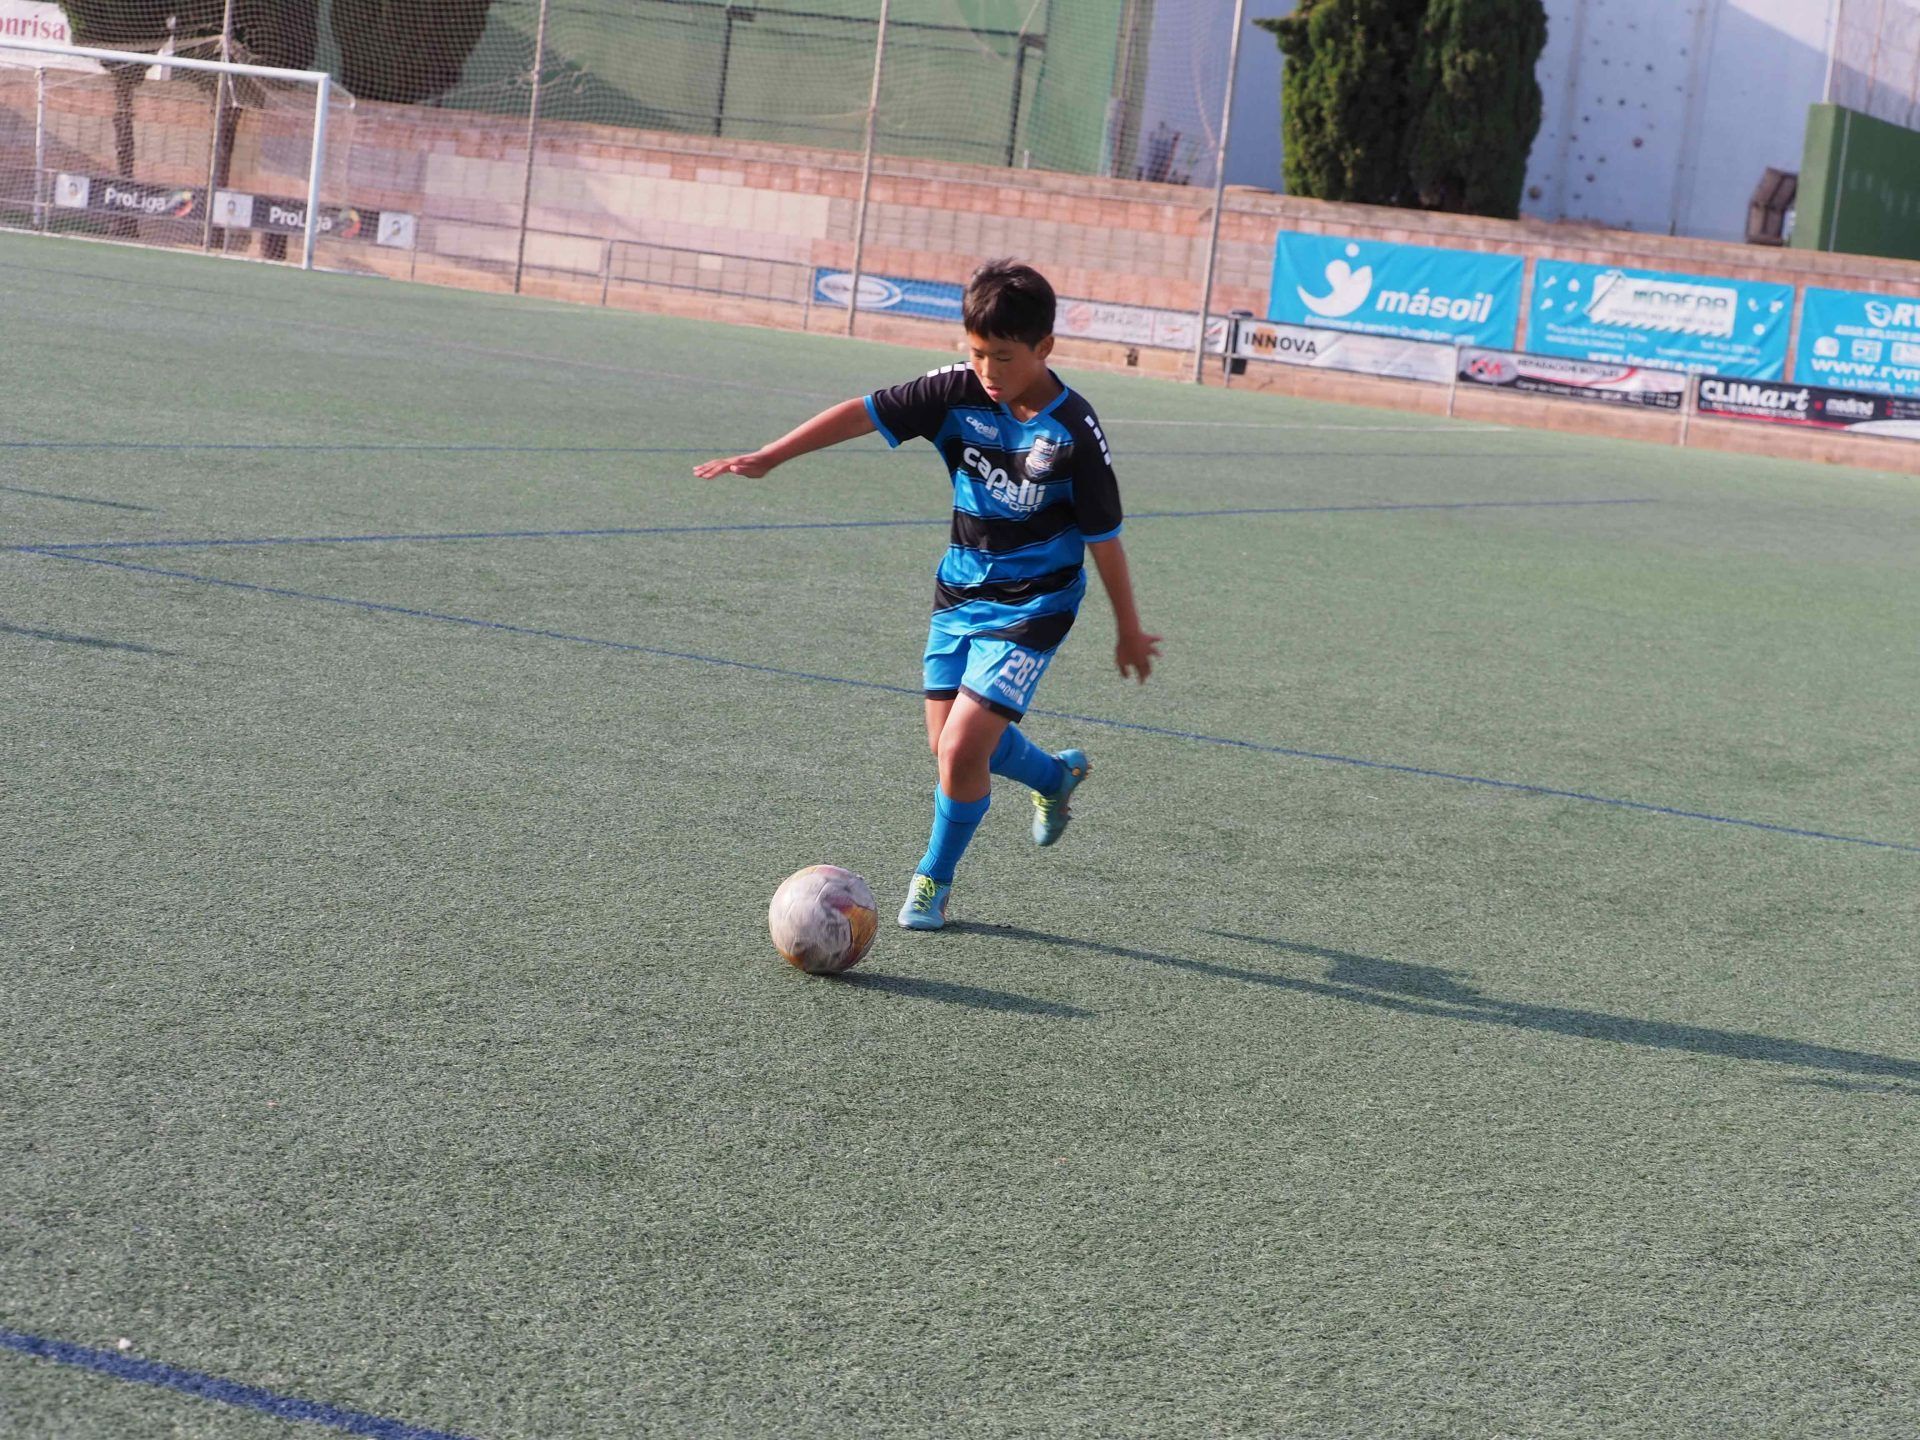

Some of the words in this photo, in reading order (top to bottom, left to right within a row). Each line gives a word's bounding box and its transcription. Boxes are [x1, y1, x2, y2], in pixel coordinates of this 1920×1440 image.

[1376, 287, 1494, 324] másoil
[1244, 331, 1317, 354] INNOVA
[1700, 379, 1810, 412] CLIMart
[963, 447, 1046, 506] capelli
[991, 488, 1041, 513] SPORT
[998, 650, 1036, 687] 28
